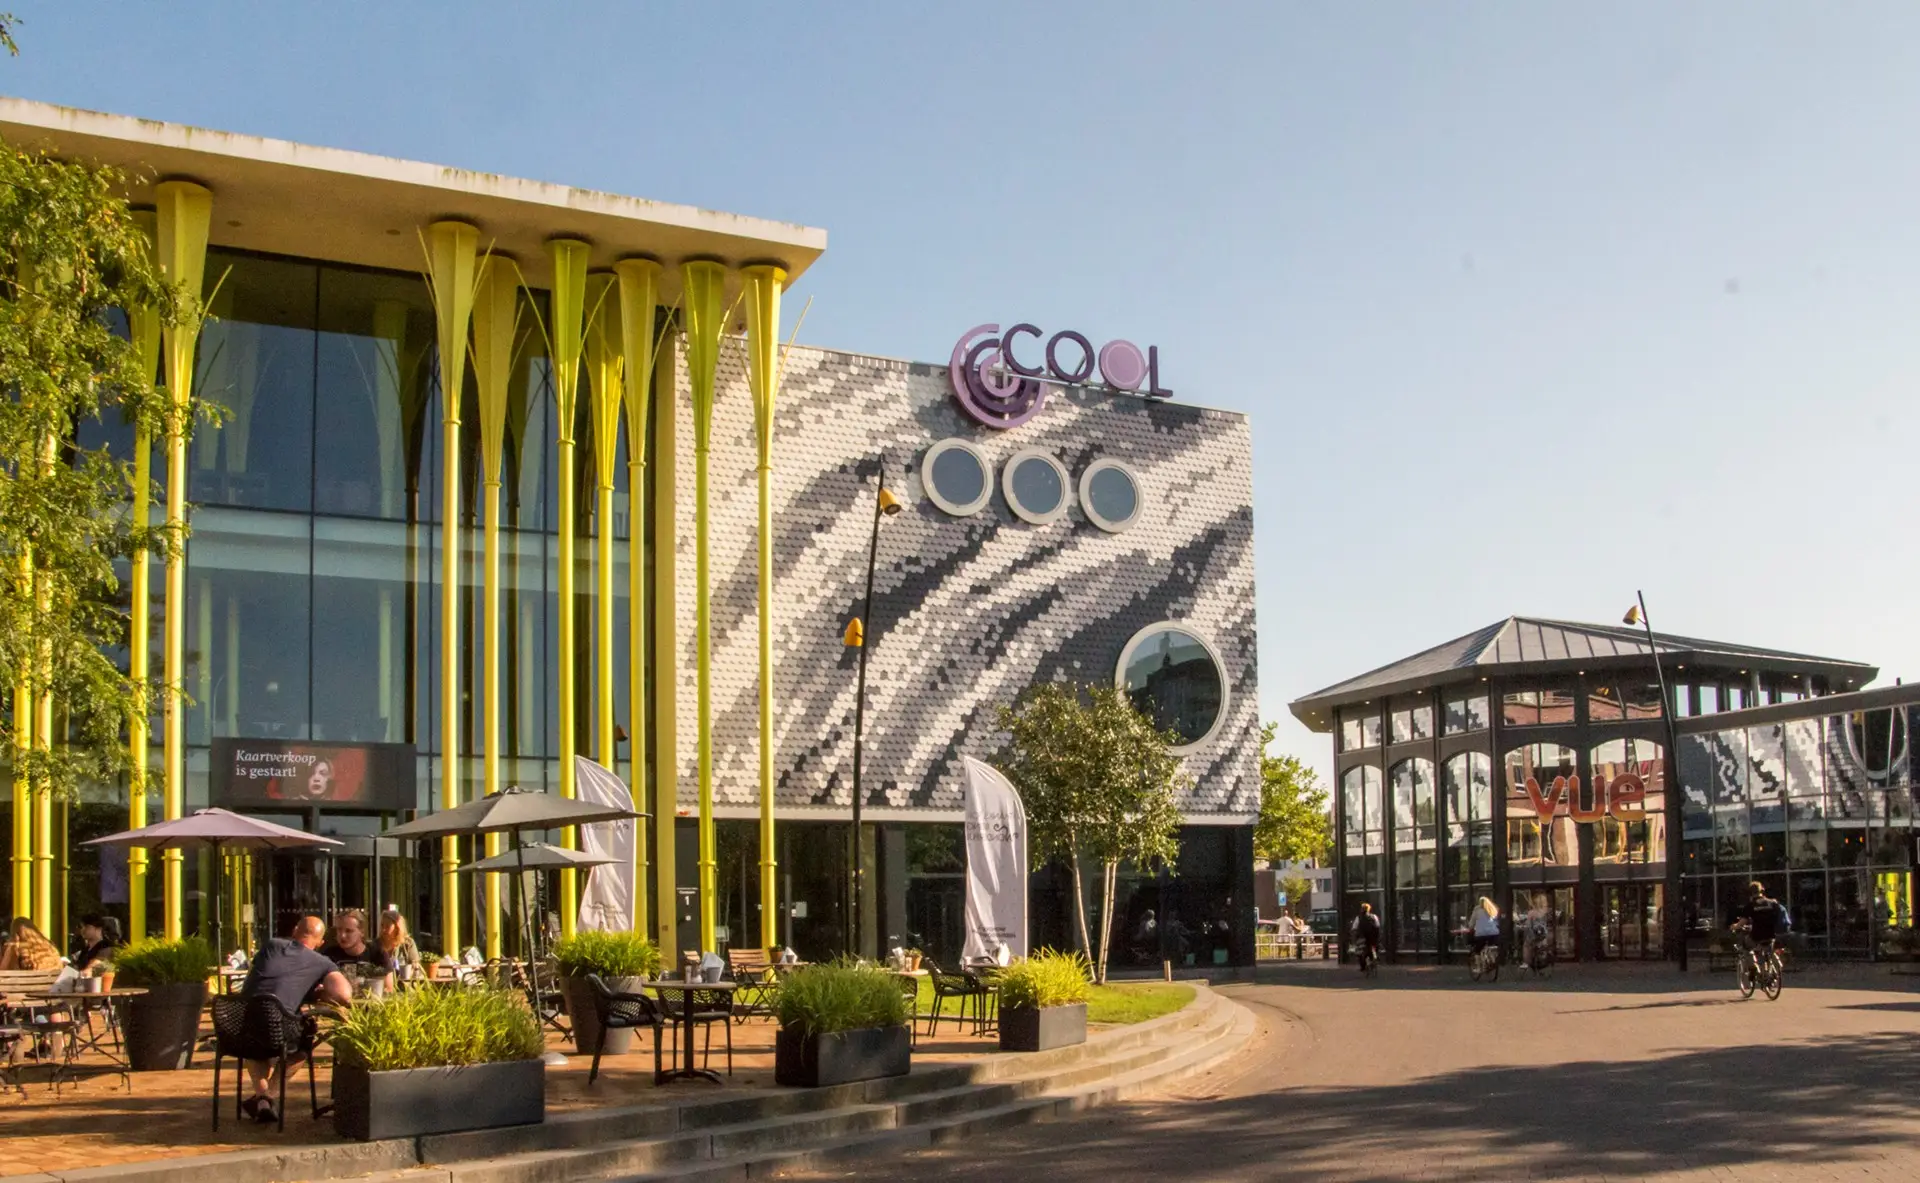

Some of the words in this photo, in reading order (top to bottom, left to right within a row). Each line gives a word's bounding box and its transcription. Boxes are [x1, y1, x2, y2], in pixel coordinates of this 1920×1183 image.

[235, 750, 316, 765] Kaartverkoop
[236, 766, 247, 776] is
[249, 766, 297, 779] gestart!
[1525, 773, 1646, 824] vue
